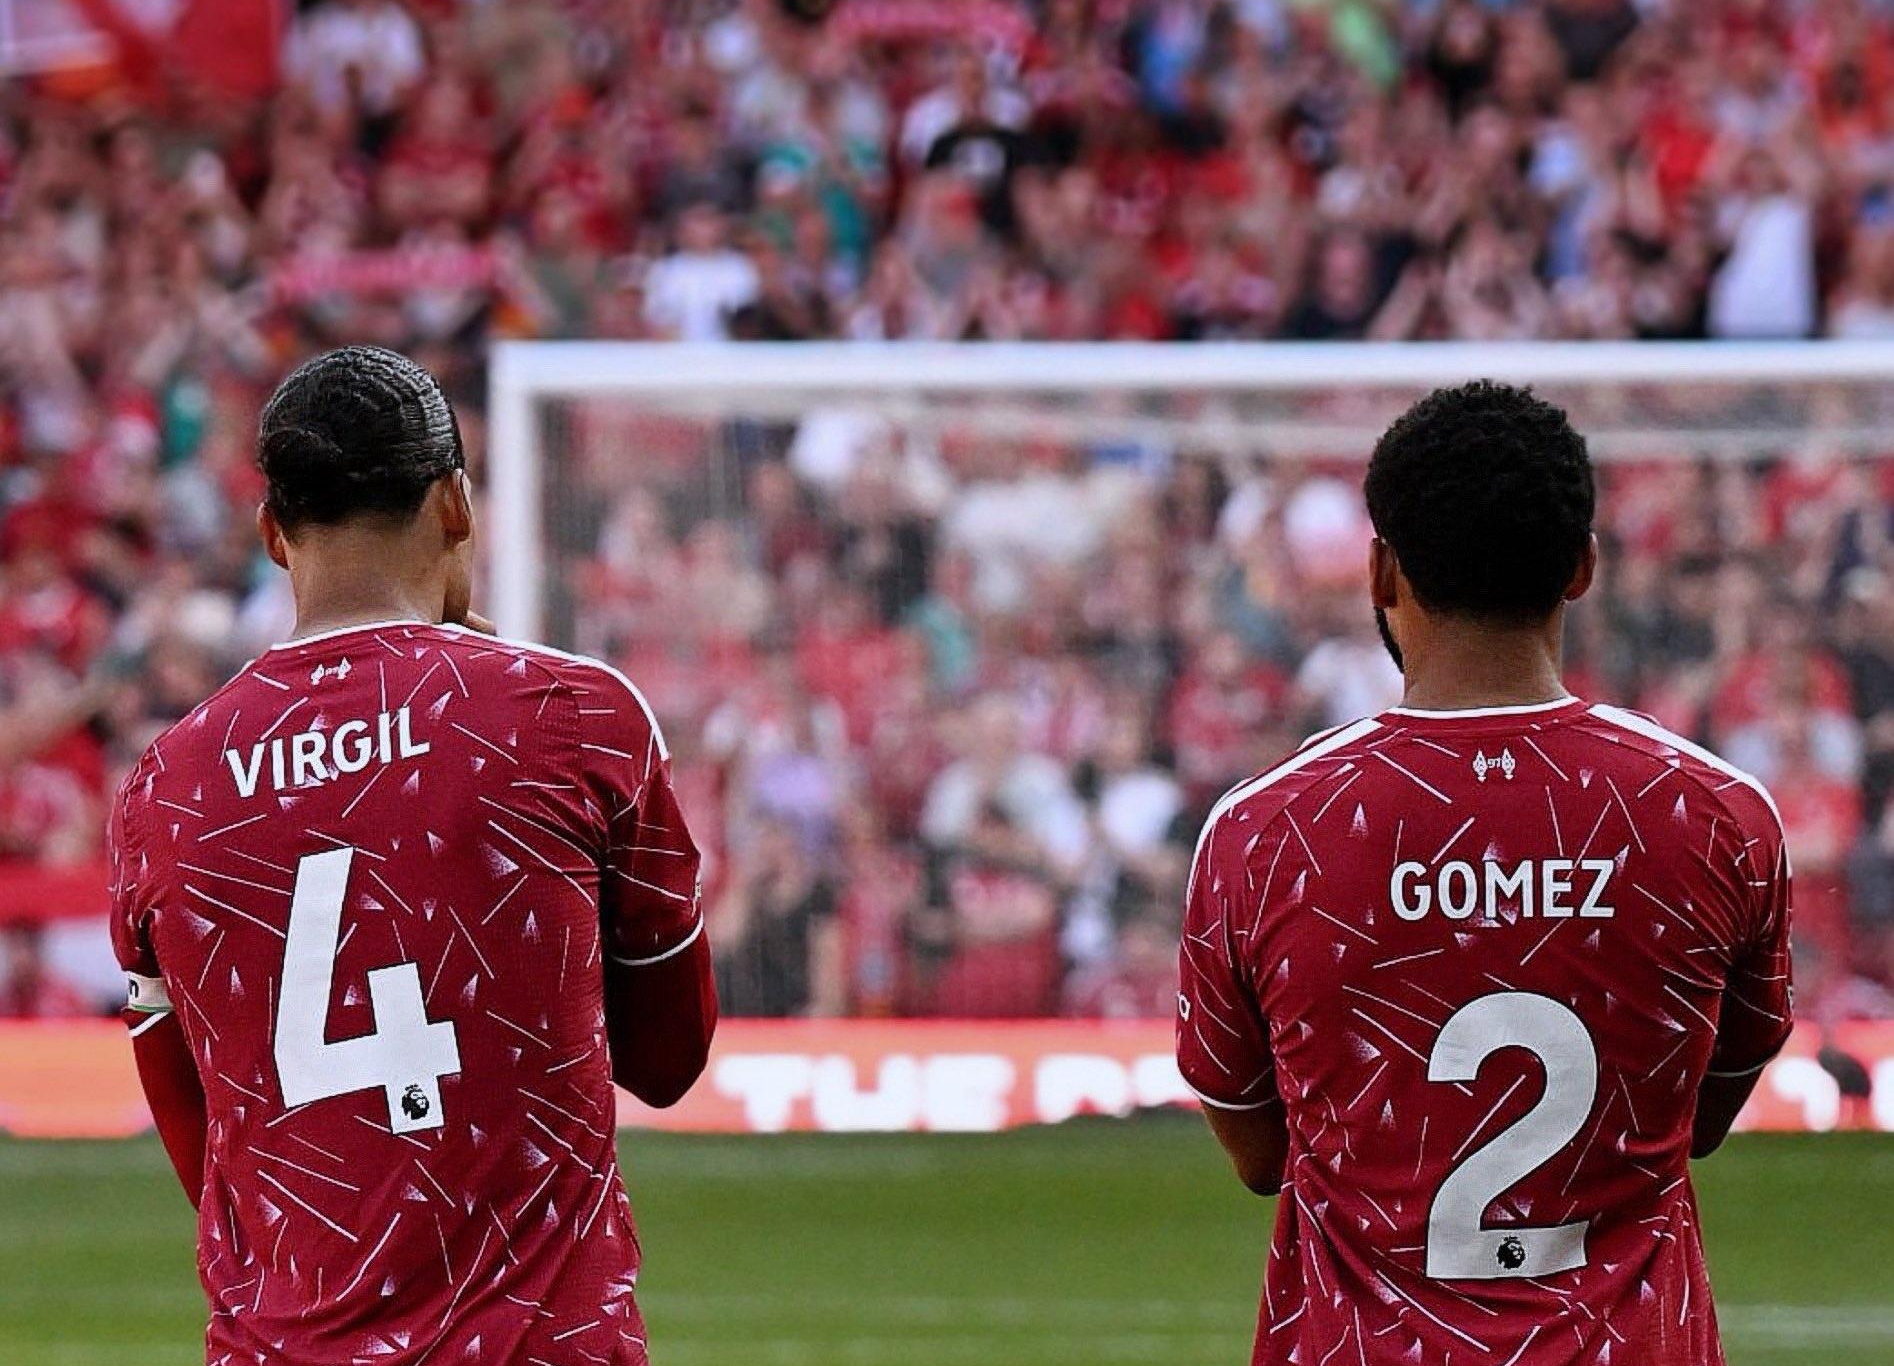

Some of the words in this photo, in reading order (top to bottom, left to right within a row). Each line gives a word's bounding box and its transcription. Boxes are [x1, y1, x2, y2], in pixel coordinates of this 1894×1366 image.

[225, 707, 430, 798] VIRGIL
[1389, 859, 1616, 922] GOMEZ
[274, 846, 461, 1135] 4
[1425, 990, 1598, 1280] 2
